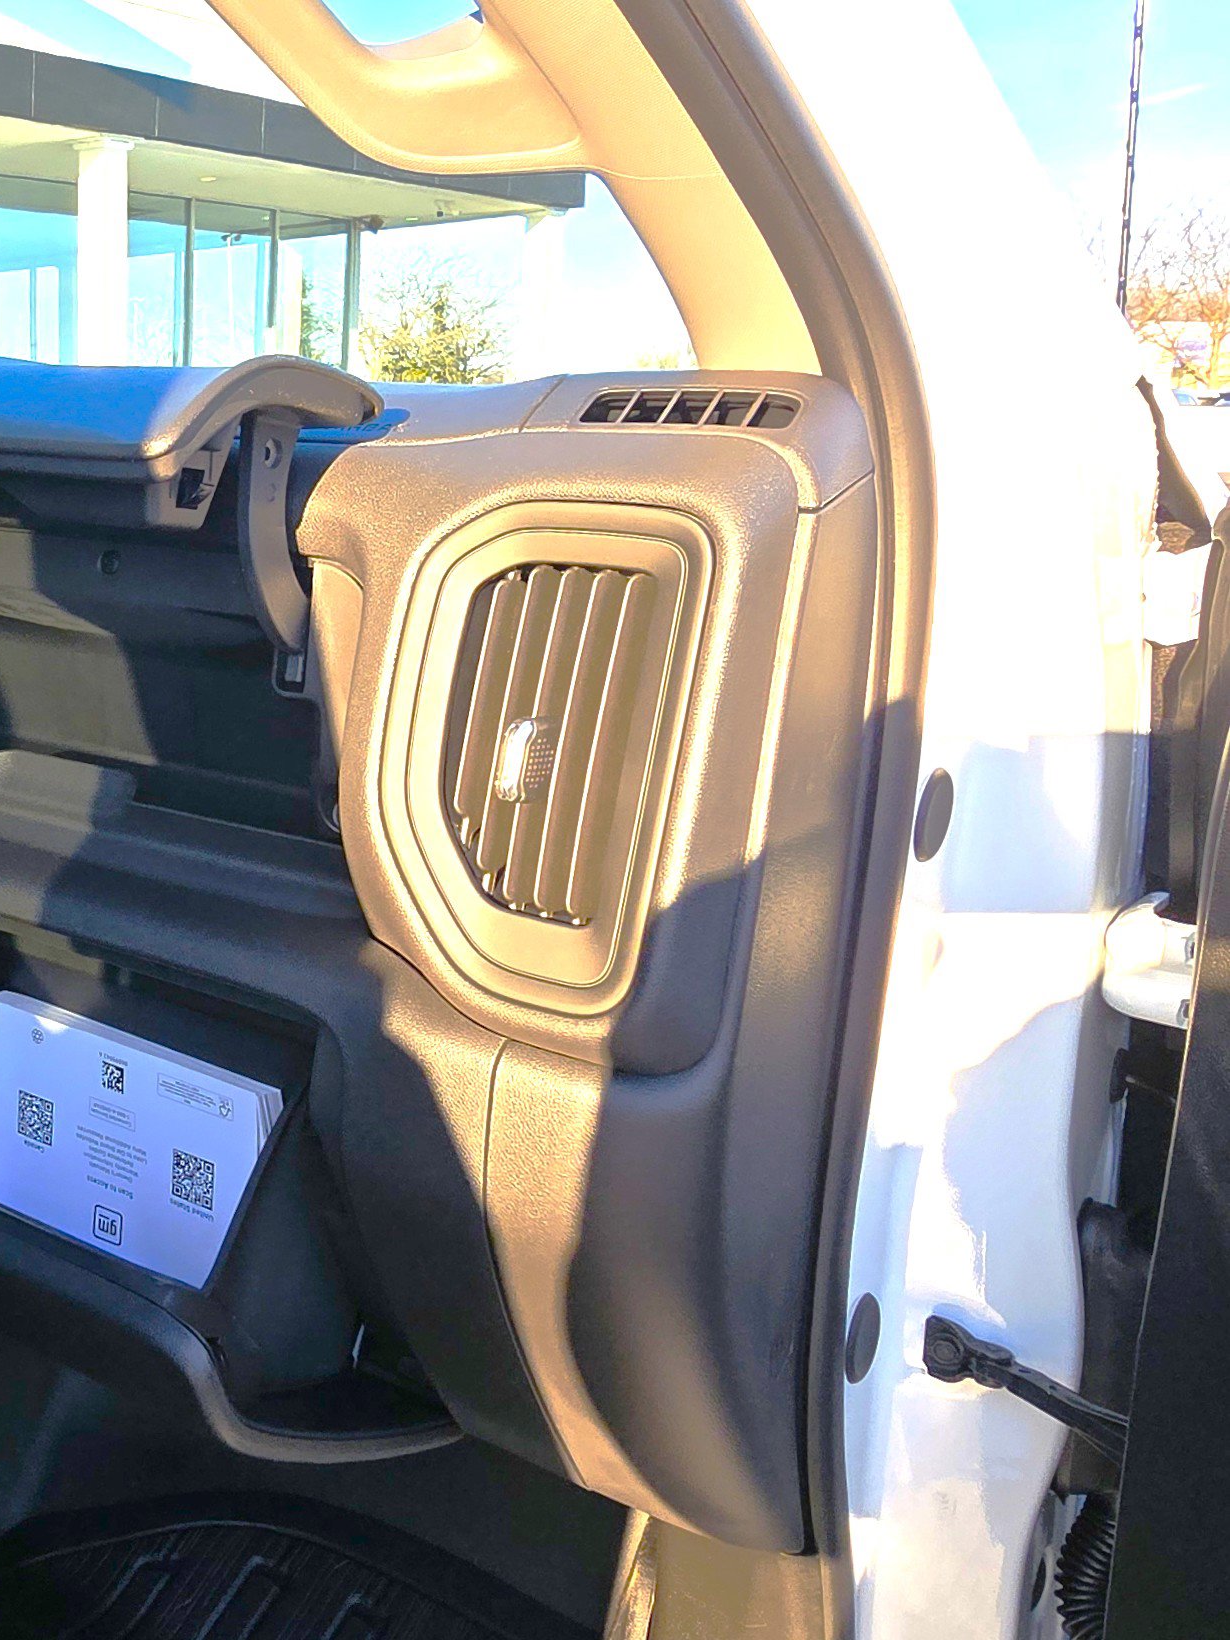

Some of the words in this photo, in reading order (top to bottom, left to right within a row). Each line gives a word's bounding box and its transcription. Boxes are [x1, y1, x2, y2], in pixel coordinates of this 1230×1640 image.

[24, 1139, 44, 1153] Canada
[87, 1174, 108, 1189] Access
[110, 1184, 116, 1192] to
[117, 1187, 133, 1200] Scan
[169, 1197, 190, 1213] States
[192, 1207, 213, 1223] United
